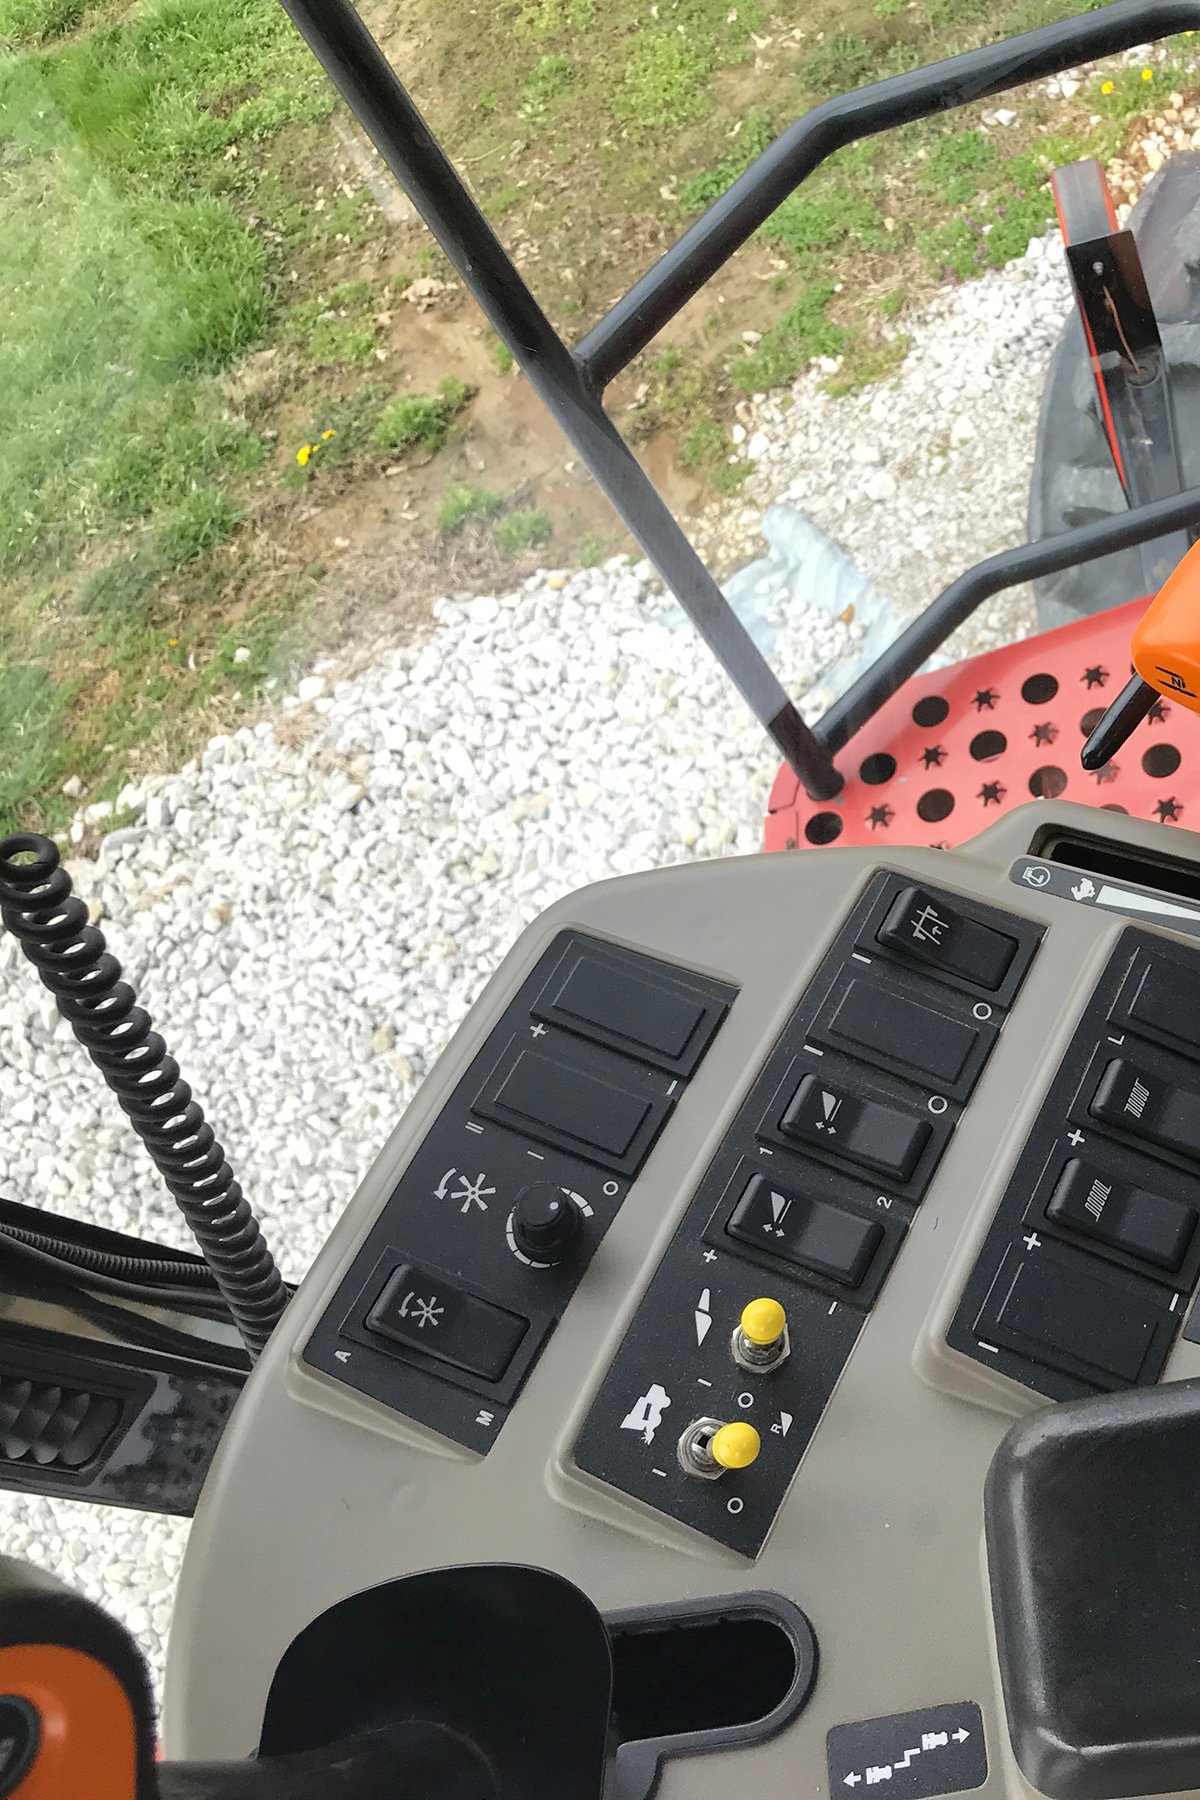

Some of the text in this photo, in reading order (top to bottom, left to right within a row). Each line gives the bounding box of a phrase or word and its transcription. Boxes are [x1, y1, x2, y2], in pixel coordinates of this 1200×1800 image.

[1107, 1035, 1125, 1045] L
[877, 1196, 892, 1209] 2
[335, 1351, 350, 1362] A
[475, 1410, 494, 1426] M
[770, 1423, 783, 1434] R
